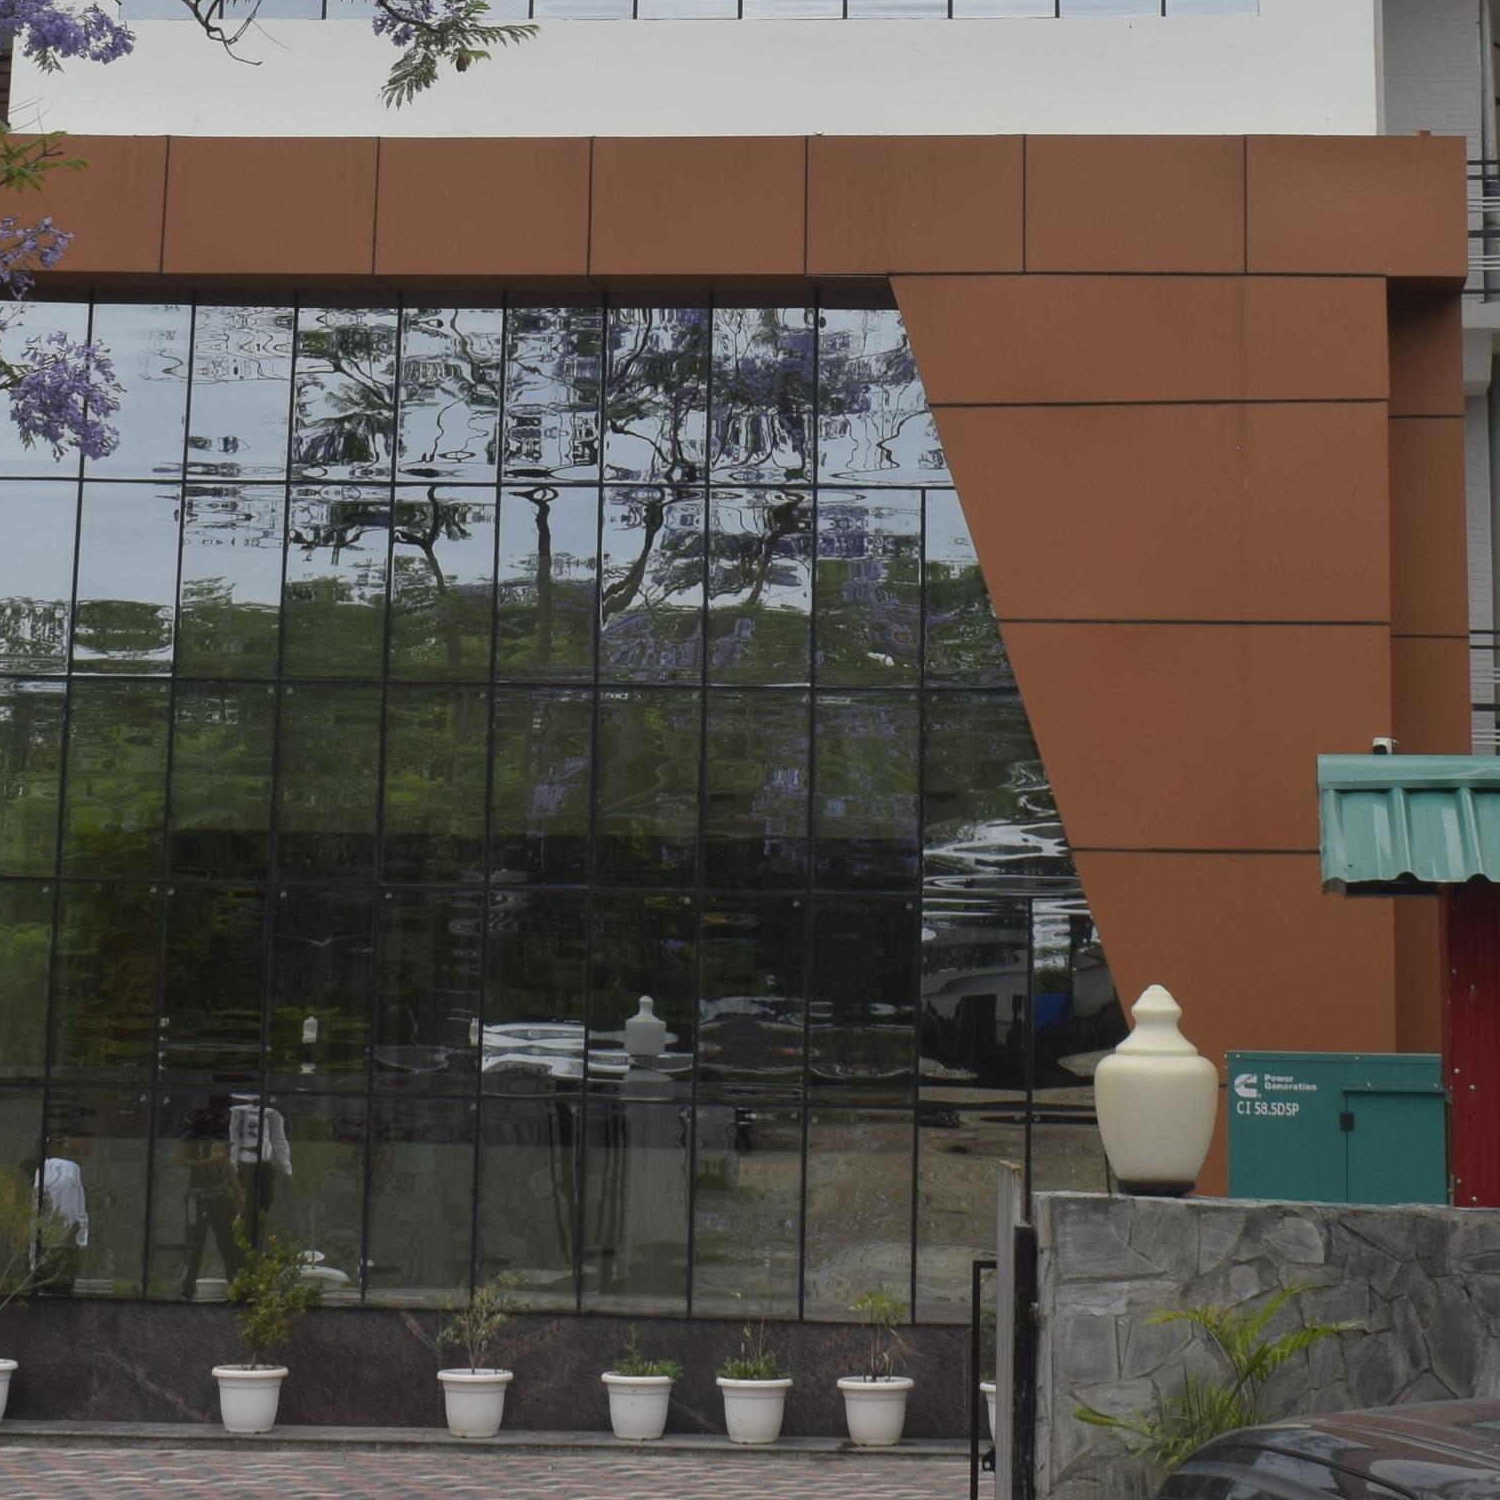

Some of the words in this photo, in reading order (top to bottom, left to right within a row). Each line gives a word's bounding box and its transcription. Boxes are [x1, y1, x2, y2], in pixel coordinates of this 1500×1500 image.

[1264, 1074, 1294, 1082] Power
[1264, 1082, 1317, 1091] Generation
[1254, 1101, 1300, 1116] 58.5D5P
